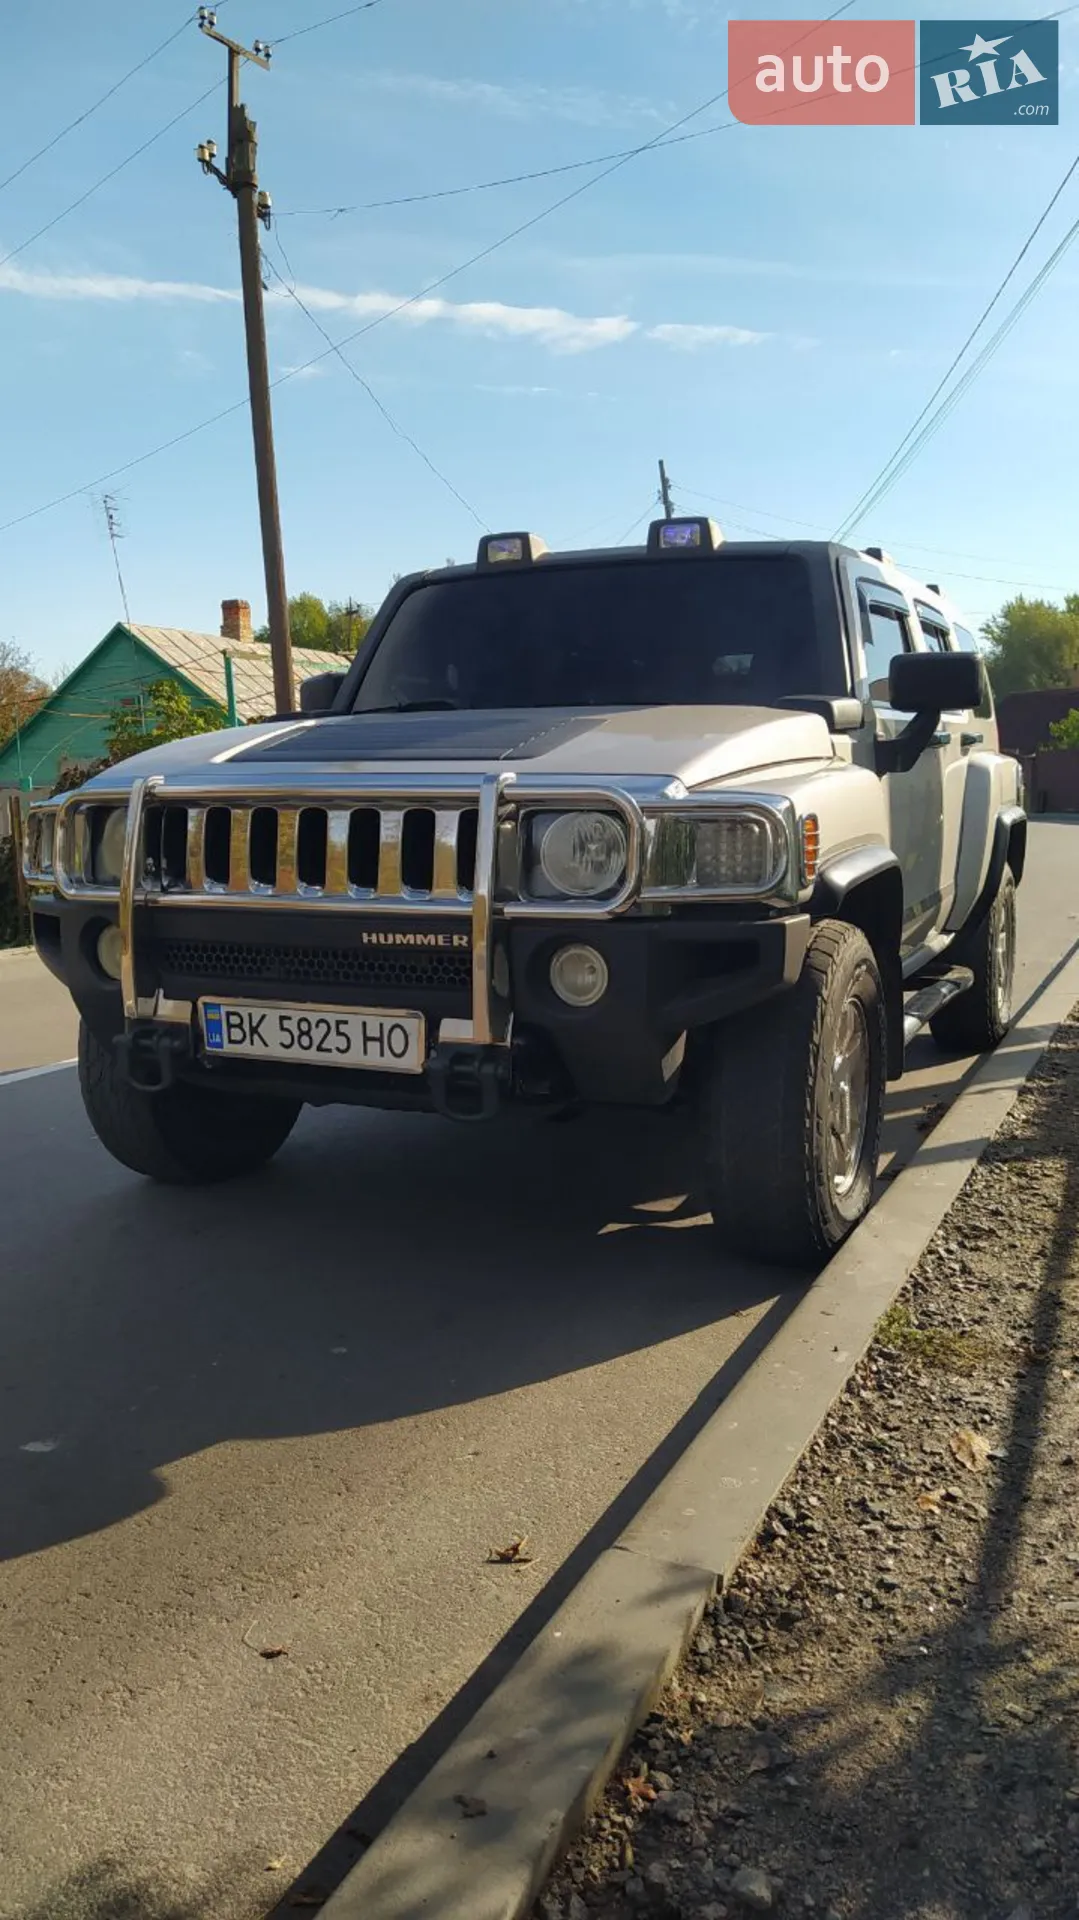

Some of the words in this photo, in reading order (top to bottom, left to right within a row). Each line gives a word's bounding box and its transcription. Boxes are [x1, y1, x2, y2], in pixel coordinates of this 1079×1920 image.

[362, 932, 469, 947] HUMMER
[208, 1033, 221, 1044] UA
[225, 1010, 269, 1048] BK
[278, 1015, 351, 1054] 5825
[361, 1020, 410, 1059] HO
